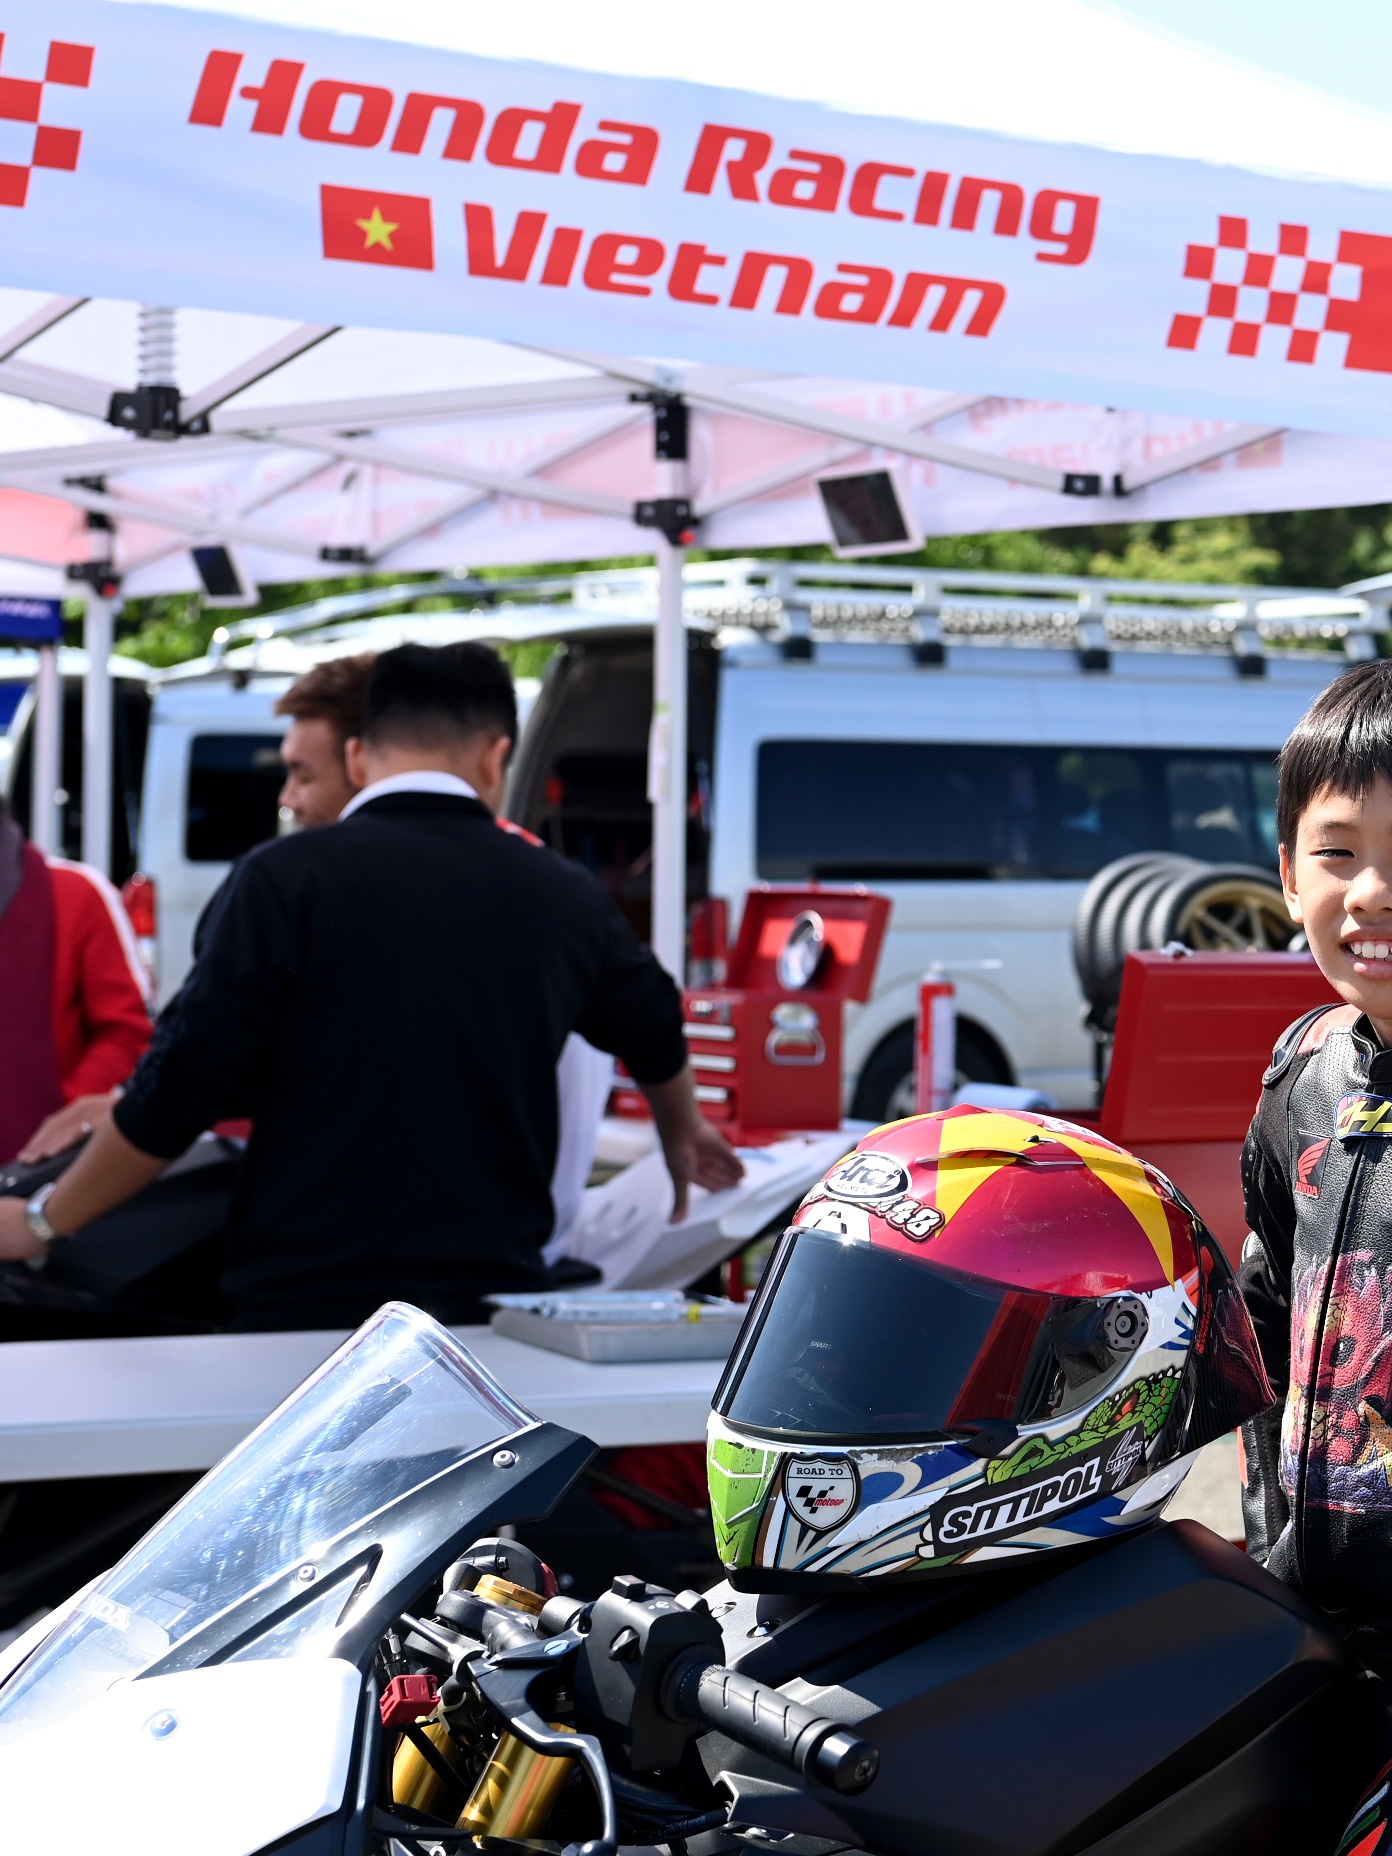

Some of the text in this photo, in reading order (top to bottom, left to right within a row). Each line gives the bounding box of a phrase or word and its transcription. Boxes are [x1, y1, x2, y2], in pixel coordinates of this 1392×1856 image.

[188, 48, 1100, 267] Honda Racing
[463, 201, 1007, 338] Vietnam
[796, 1467, 844, 1476] ROAD TO
[941, 1461, 1099, 1540] SITTIPOL
